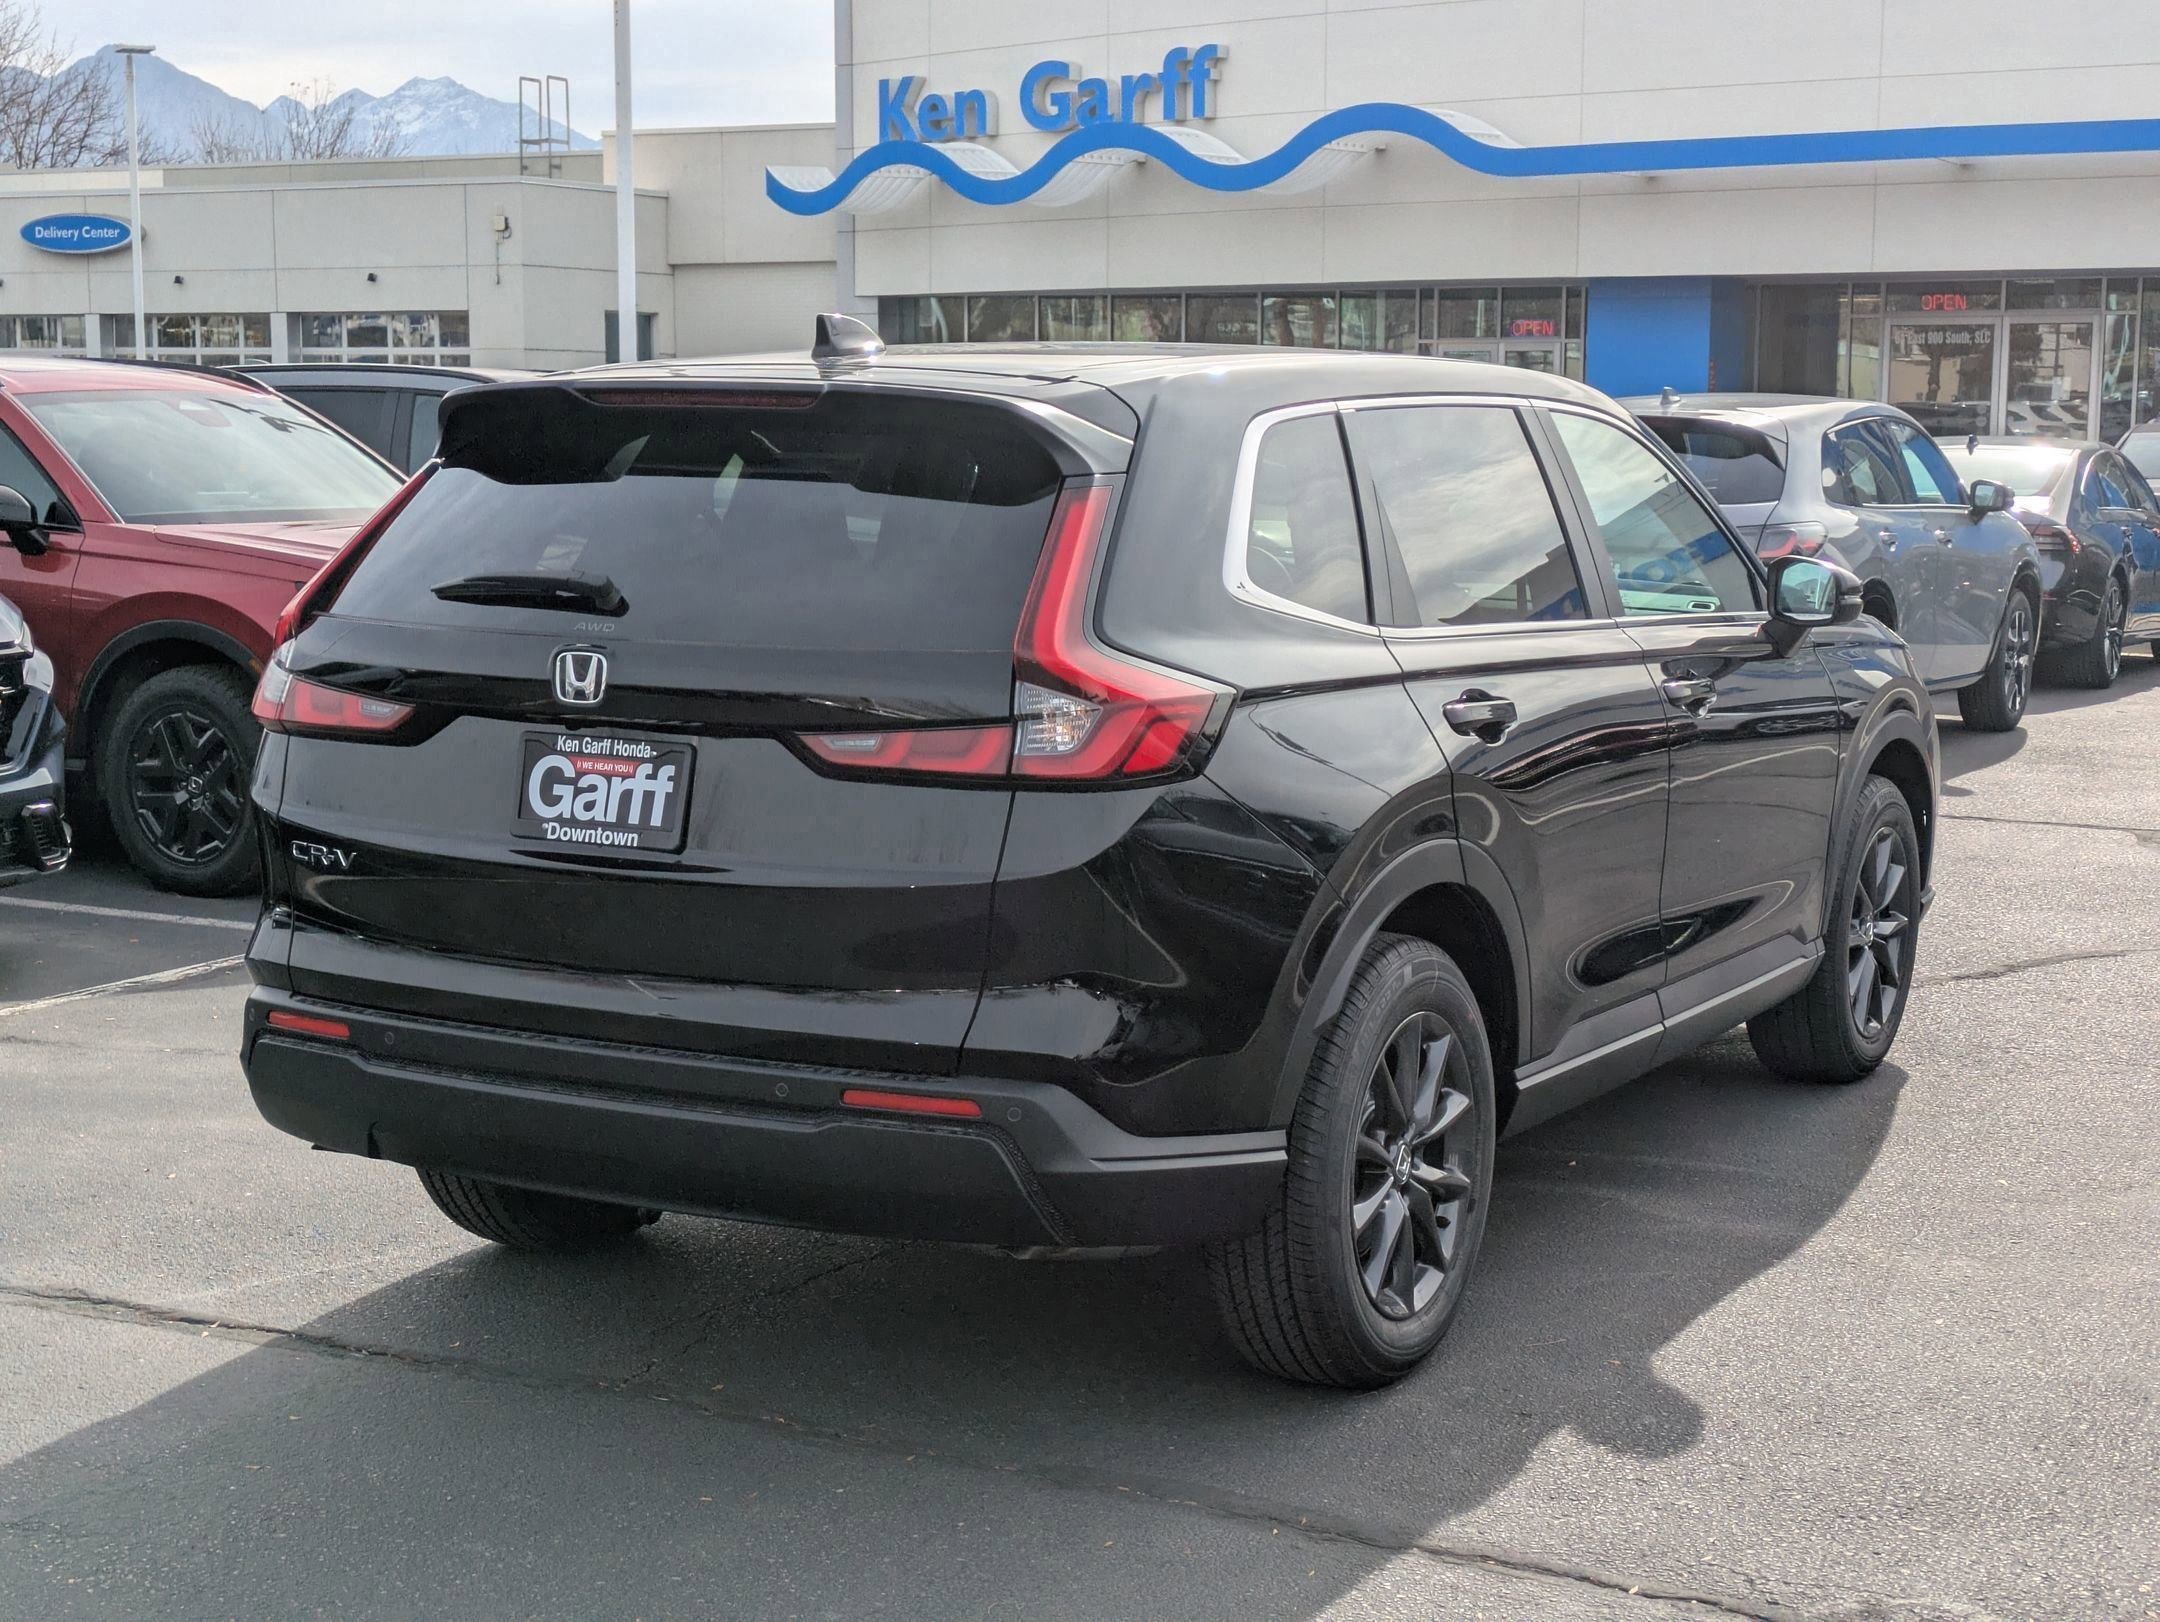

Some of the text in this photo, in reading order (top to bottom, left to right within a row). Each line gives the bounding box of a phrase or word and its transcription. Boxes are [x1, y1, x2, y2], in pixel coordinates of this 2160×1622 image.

[878, 44, 1228, 144] Ken Garff
[34, 226, 120, 241] Delivery Center
[1921, 293, 1967, 312] OPEN
[1511, 319, 1554, 337] OPEN
[573, 621, 615, 632] AWD
[557, 735, 651, 758] Ken Garff Honda
[582, 761, 629, 773] WE HEAR YOU
[528, 754, 676, 827] Garff
[546, 822, 639, 847] Downtown
[291, 840, 357, 870] CR-V
